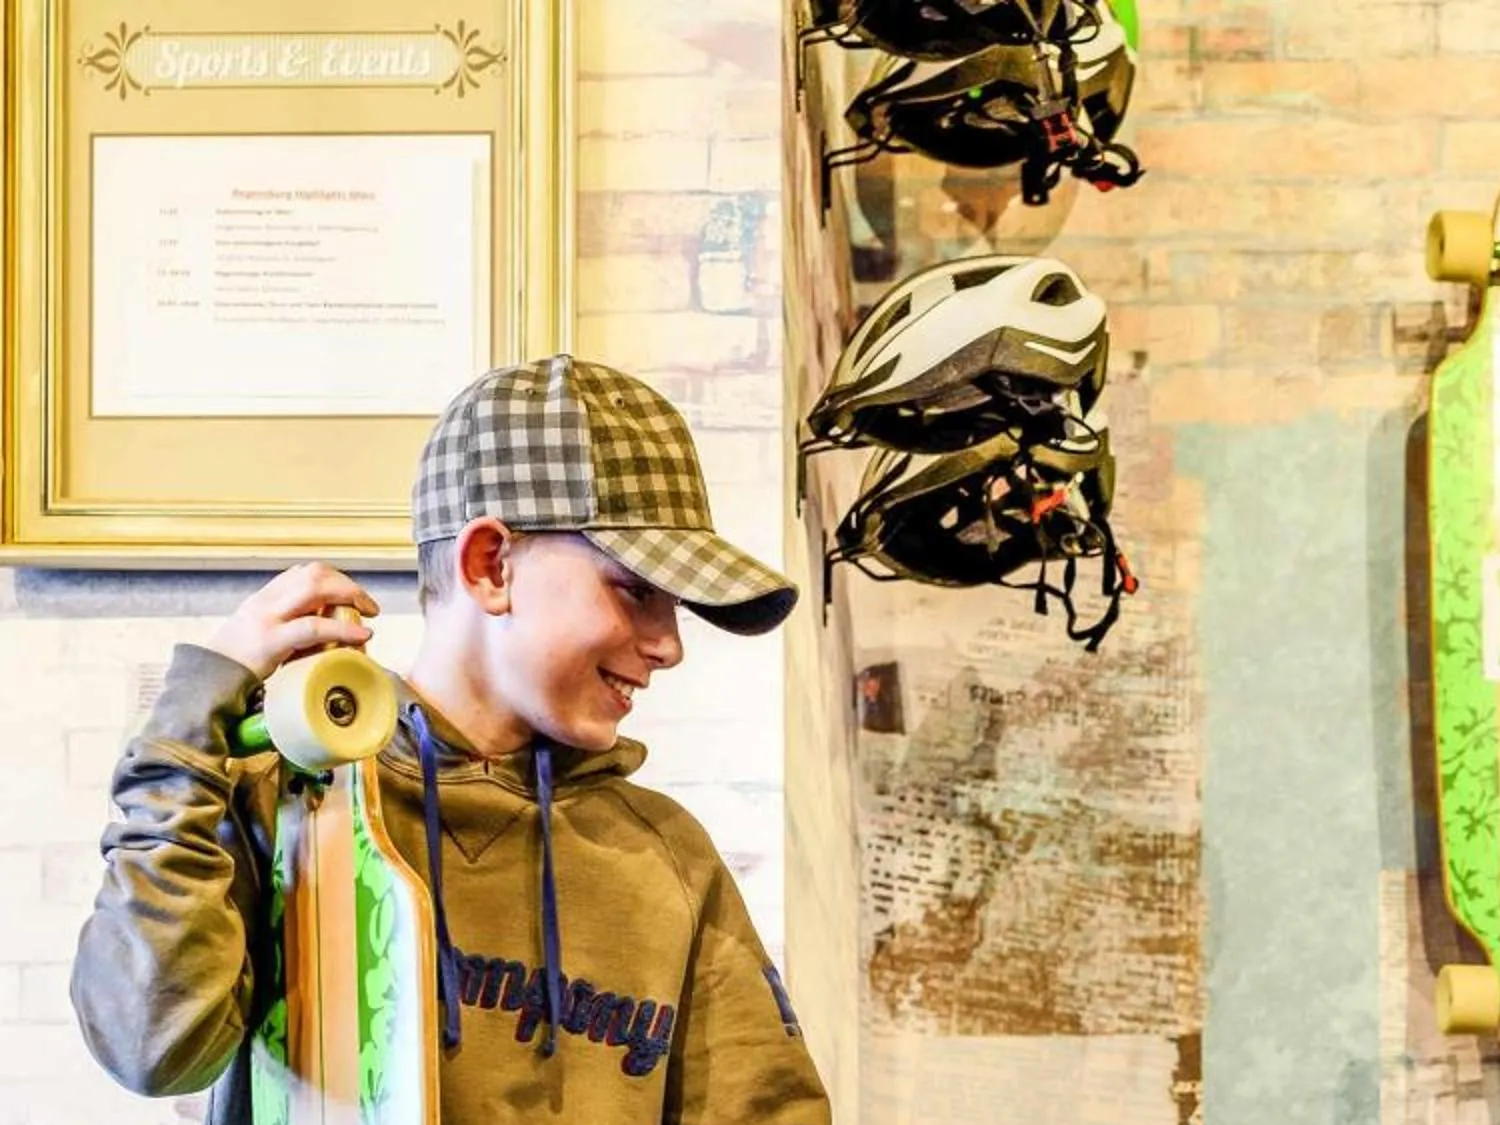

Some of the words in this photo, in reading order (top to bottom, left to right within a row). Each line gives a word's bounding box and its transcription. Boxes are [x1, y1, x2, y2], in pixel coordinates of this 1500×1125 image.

[155, 40, 268, 88] Sports
[277, 41, 309, 77] &
[321, 40, 432, 76] Events
